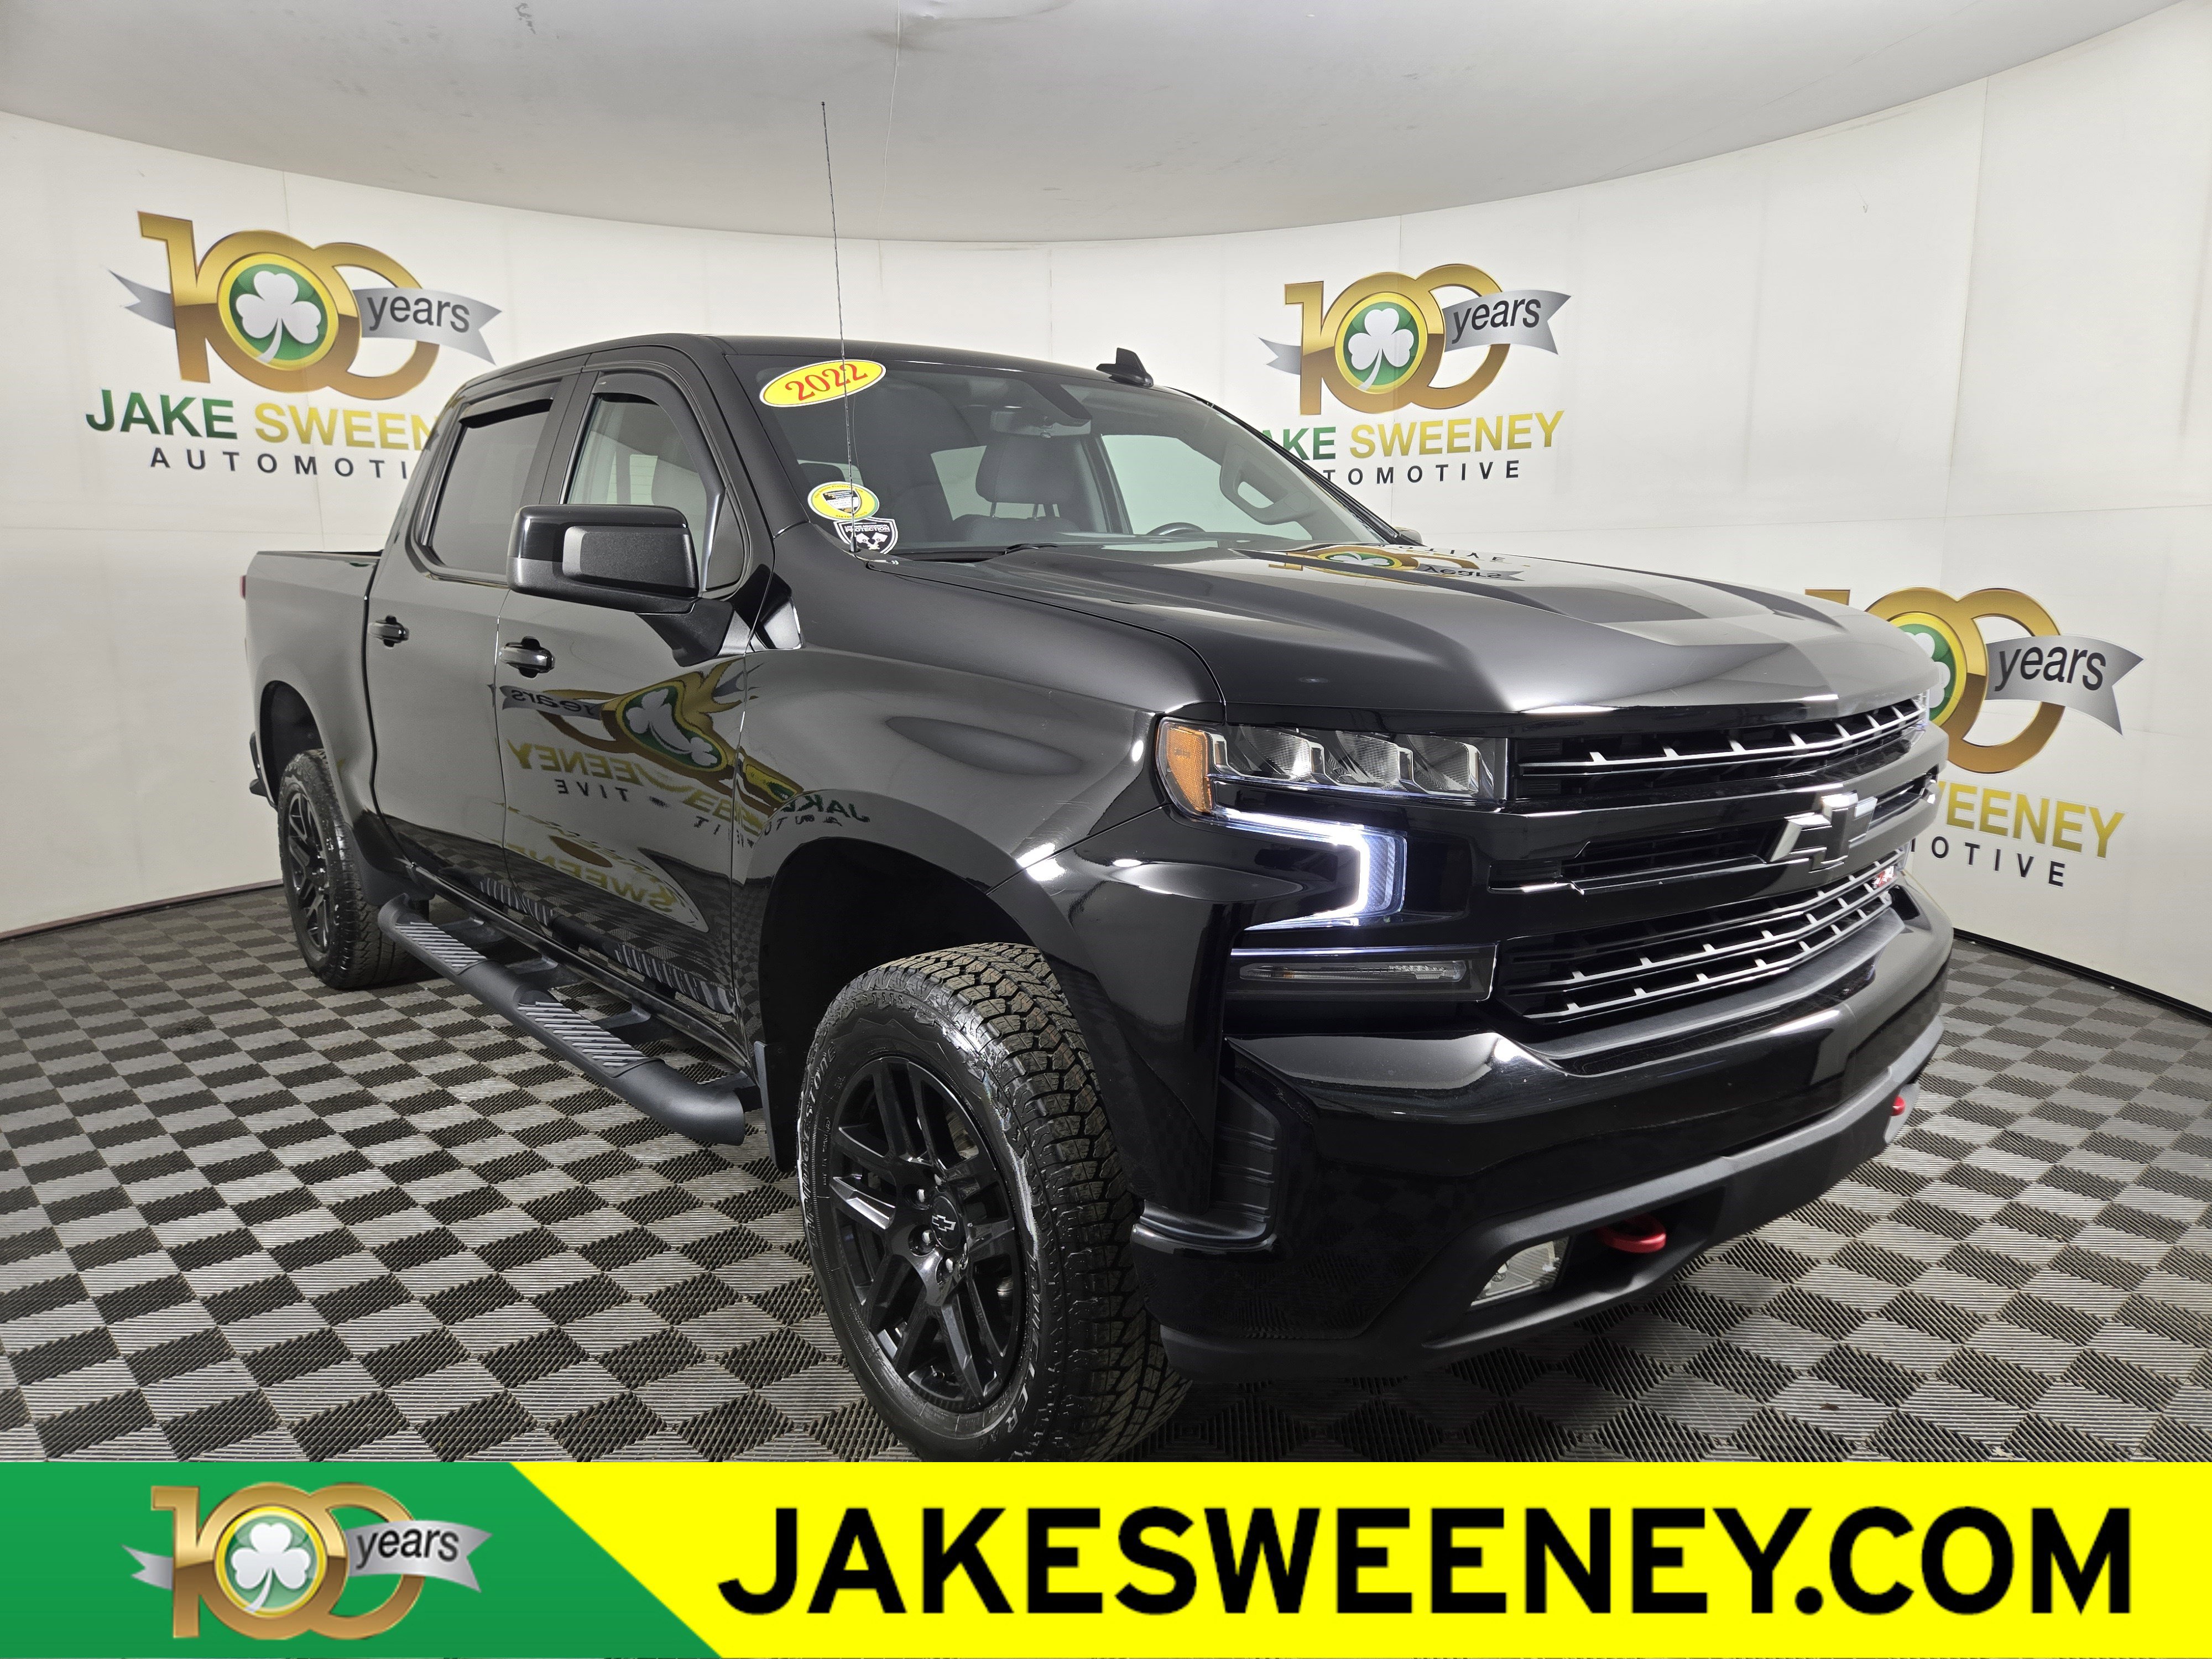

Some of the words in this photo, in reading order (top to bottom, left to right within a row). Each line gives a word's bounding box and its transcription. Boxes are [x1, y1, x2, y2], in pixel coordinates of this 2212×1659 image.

[138, 211, 440, 400] 100
[367, 294, 472, 332] years
[1284, 263, 1510, 415] 100
[1451, 297, 1542, 344] years
[785, 363, 869, 401] 2022
[85, 388, 238, 440] JAKE
[254, 403, 439, 451] SWEEN
[1262, 426, 1336, 461] KE
[1349, 410, 1565, 459] SWEENEY
[150, 447, 408, 479] AUTOMOTI
[1323, 460, 1520, 486] TOMOTIVE
[1994, 645, 2106, 691] years
[1938, 780, 2125, 859] EENEY
[1911, 836, 2066, 887] OTIVE
